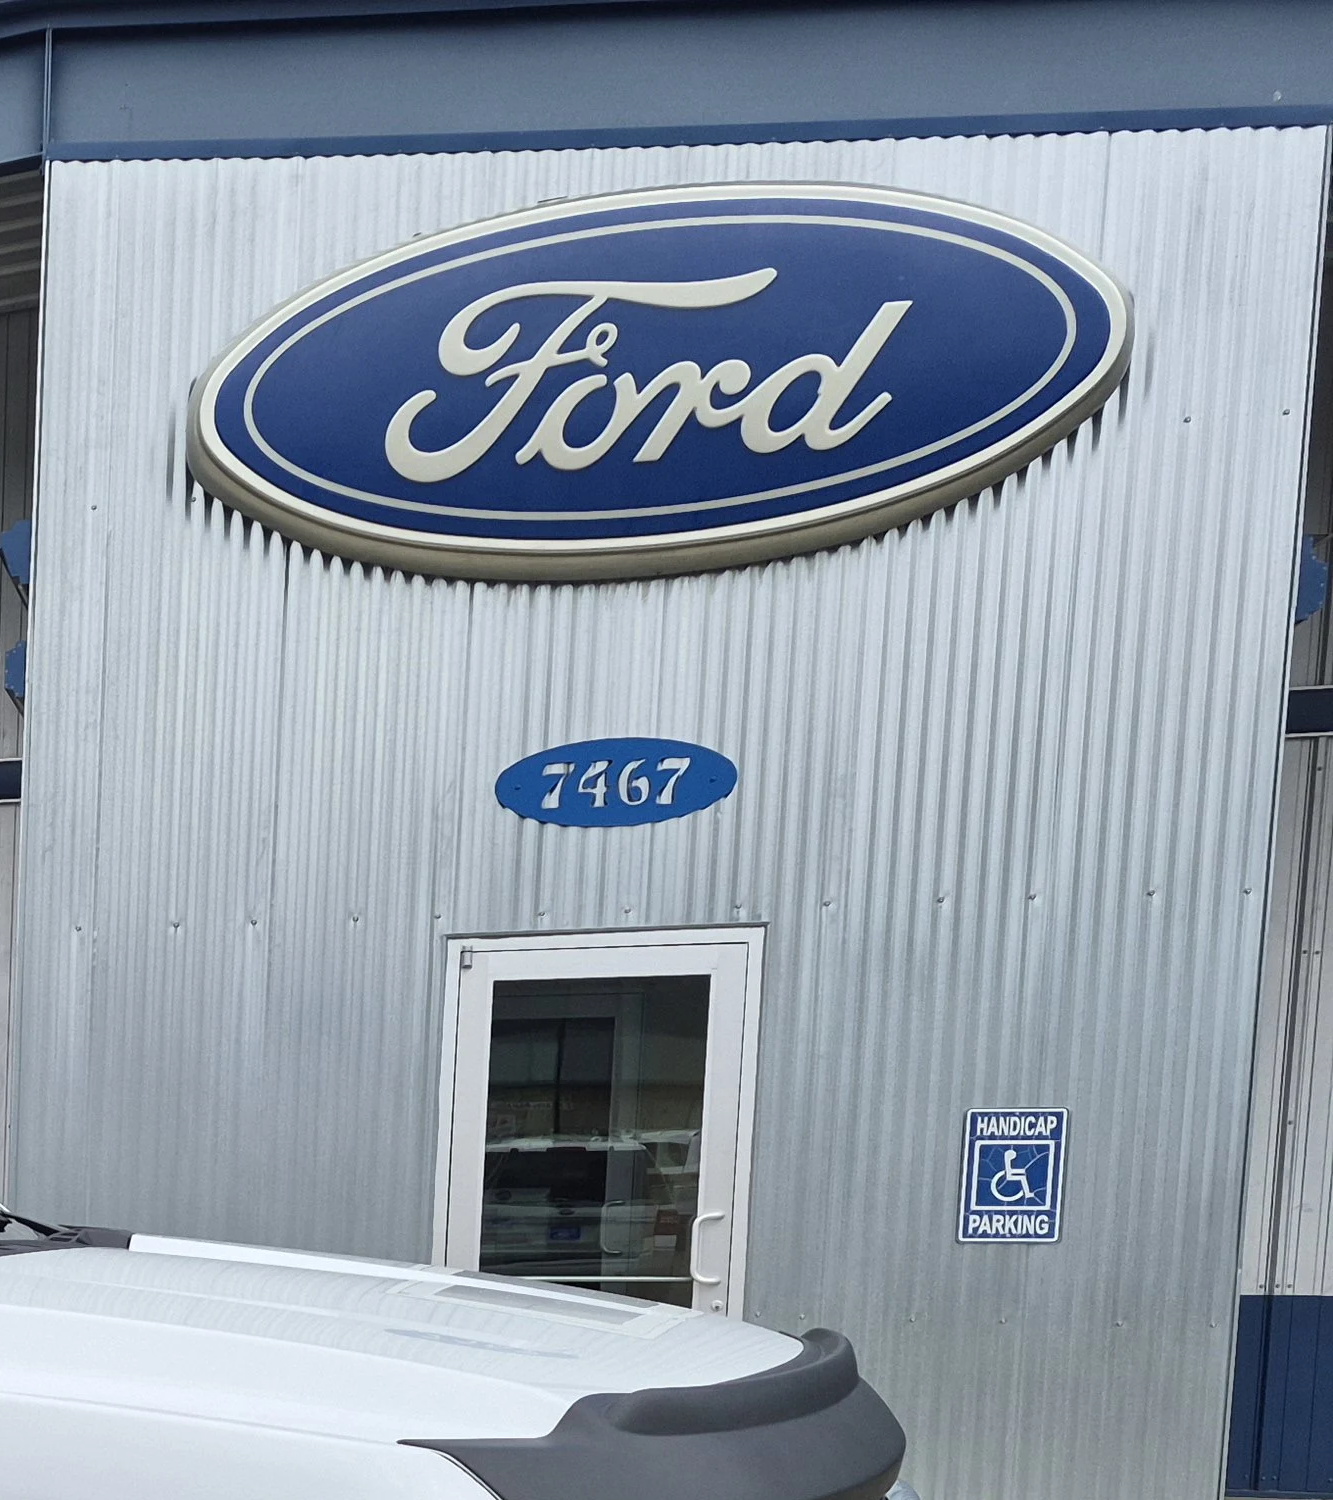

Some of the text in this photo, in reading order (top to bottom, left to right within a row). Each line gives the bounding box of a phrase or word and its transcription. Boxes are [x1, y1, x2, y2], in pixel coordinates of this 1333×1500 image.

[384, 266, 914, 484] Ford
[541, 757, 691, 810] 7467
[976, 1115, 1058, 1136] HANDICAP
[968, 1213, 1050, 1235] PARKING
